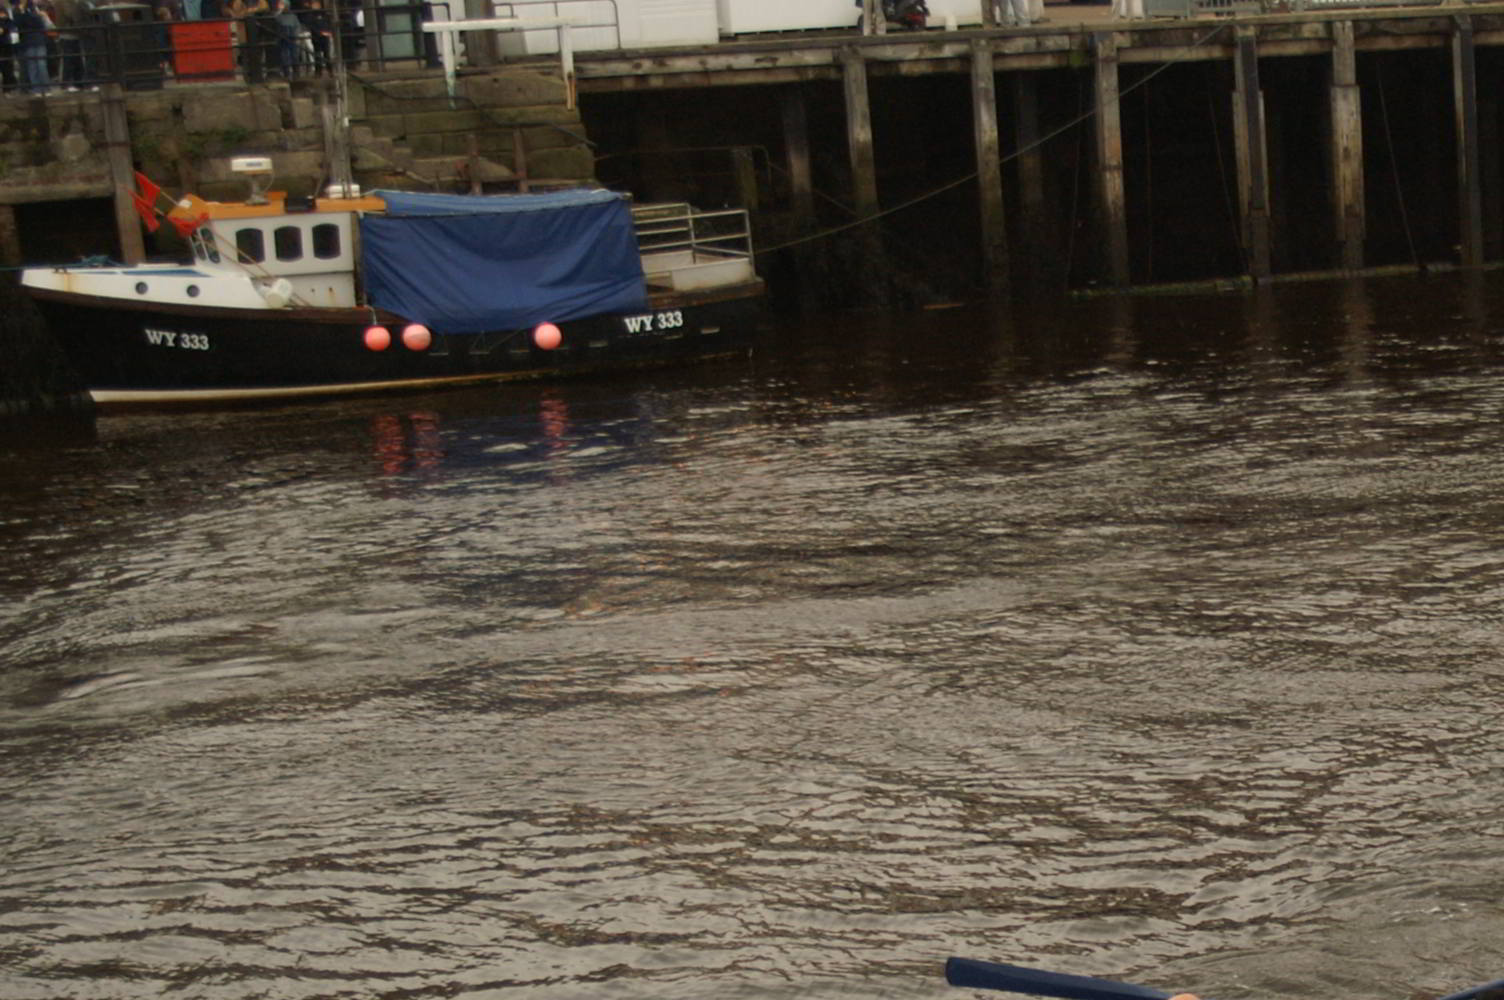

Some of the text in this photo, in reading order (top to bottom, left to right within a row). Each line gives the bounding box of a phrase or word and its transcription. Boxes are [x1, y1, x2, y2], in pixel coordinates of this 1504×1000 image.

[624, 311, 683, 333] WY 333
[145, 329, 209, 350] WY 333
